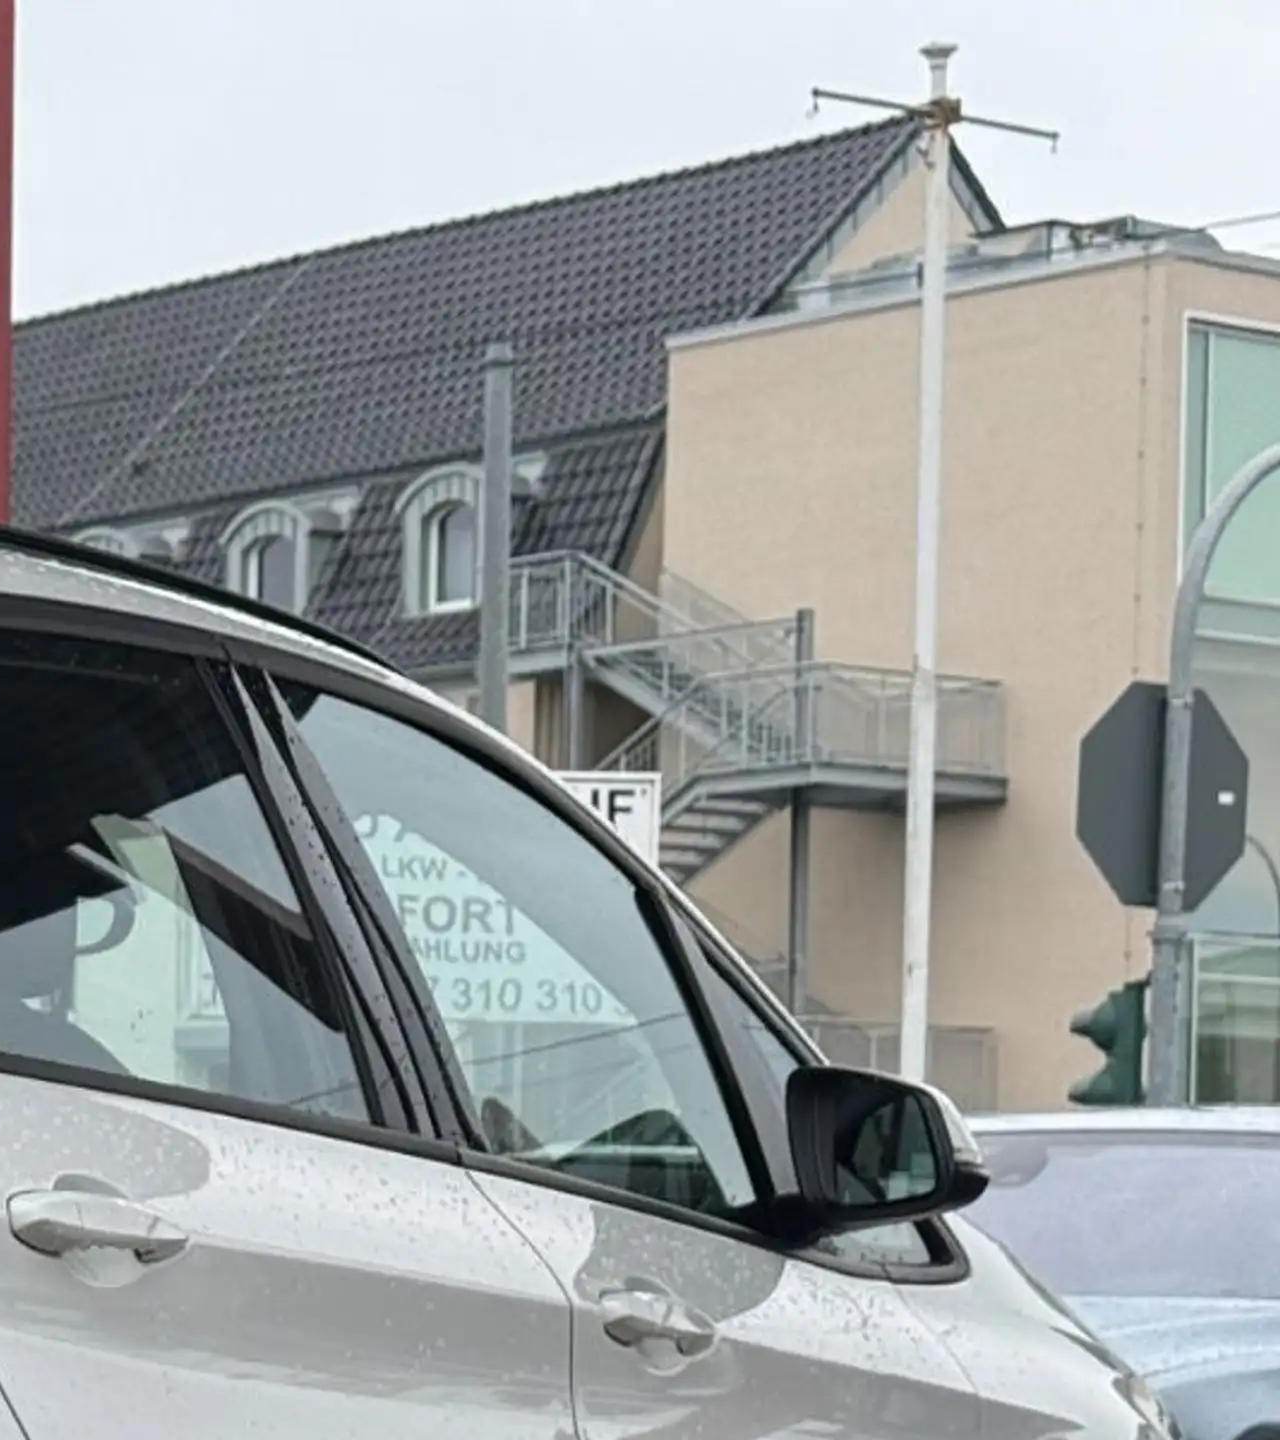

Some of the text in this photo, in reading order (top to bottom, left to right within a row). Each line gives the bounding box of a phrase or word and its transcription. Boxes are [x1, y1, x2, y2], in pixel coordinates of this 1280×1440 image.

[381, 854, 449, 882] LKW
[451, 977, 523, 1013] 310
[536, 978, 604, 1016] 310
